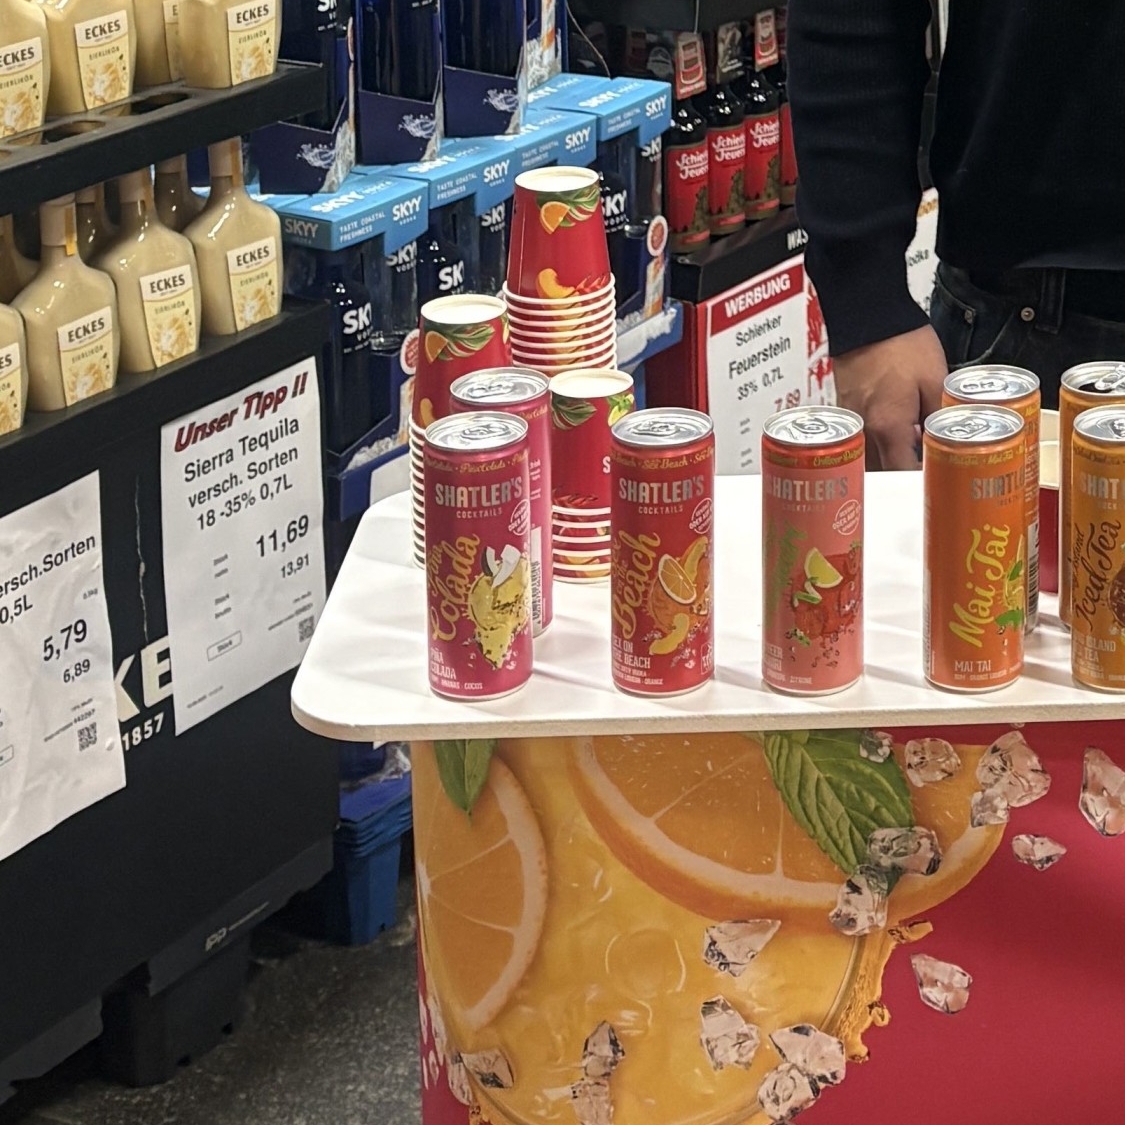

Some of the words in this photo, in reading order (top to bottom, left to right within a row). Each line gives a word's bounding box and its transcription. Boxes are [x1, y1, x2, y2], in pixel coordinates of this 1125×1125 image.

[236, 5, 270, 24] ECKES
[84, 20, 121, 40] ECKES
[645, 95, 667, 117] SKYY
[565, 128, 592, 150] SKYY
[483, 160, 510, 183] SKYY
[392, 195, 422, 222] SKYY
[284, 218, 318, 238] SKYY
[236, 246, 270, 267] ECKES
[149, 274, 186, 294] ECKES
[724, 273, 791, 318] WERBUNG
[67, 318, 105, 343] ECKES
[735, 315, 782, 347] Schierker
[728, 336, 791, 379] Feuerstein
[174, 407, 239, 453] Unser
[243, 385, 288, 420] Tipp
[184, 447, 234, 483] Sierra
[238, 417, 299, 457] Tequila
[188, 472, 243, 508] versch.
[246, 447, 298, 480] Sorten
[619, 475, 704, 504] SHATLER'S
[197, 509, 216, 530] 18
[259, 473, 293, 501] 0,7L
[435, 476, 523, 508] SHATLER'S
[456, 508, 503, 519] COCKTAILS
[638, 505, 684, 515] COCKTAILS
[256, 514, 309, 557] 11,69
[280, 553, 310, 579] 13,91
[43, 618, 87, 662] 5,79
[63, 658, 91, 683] 6,89
[954, 659, 974, 672] MAI
[977, 659, 991, 671] TAI
